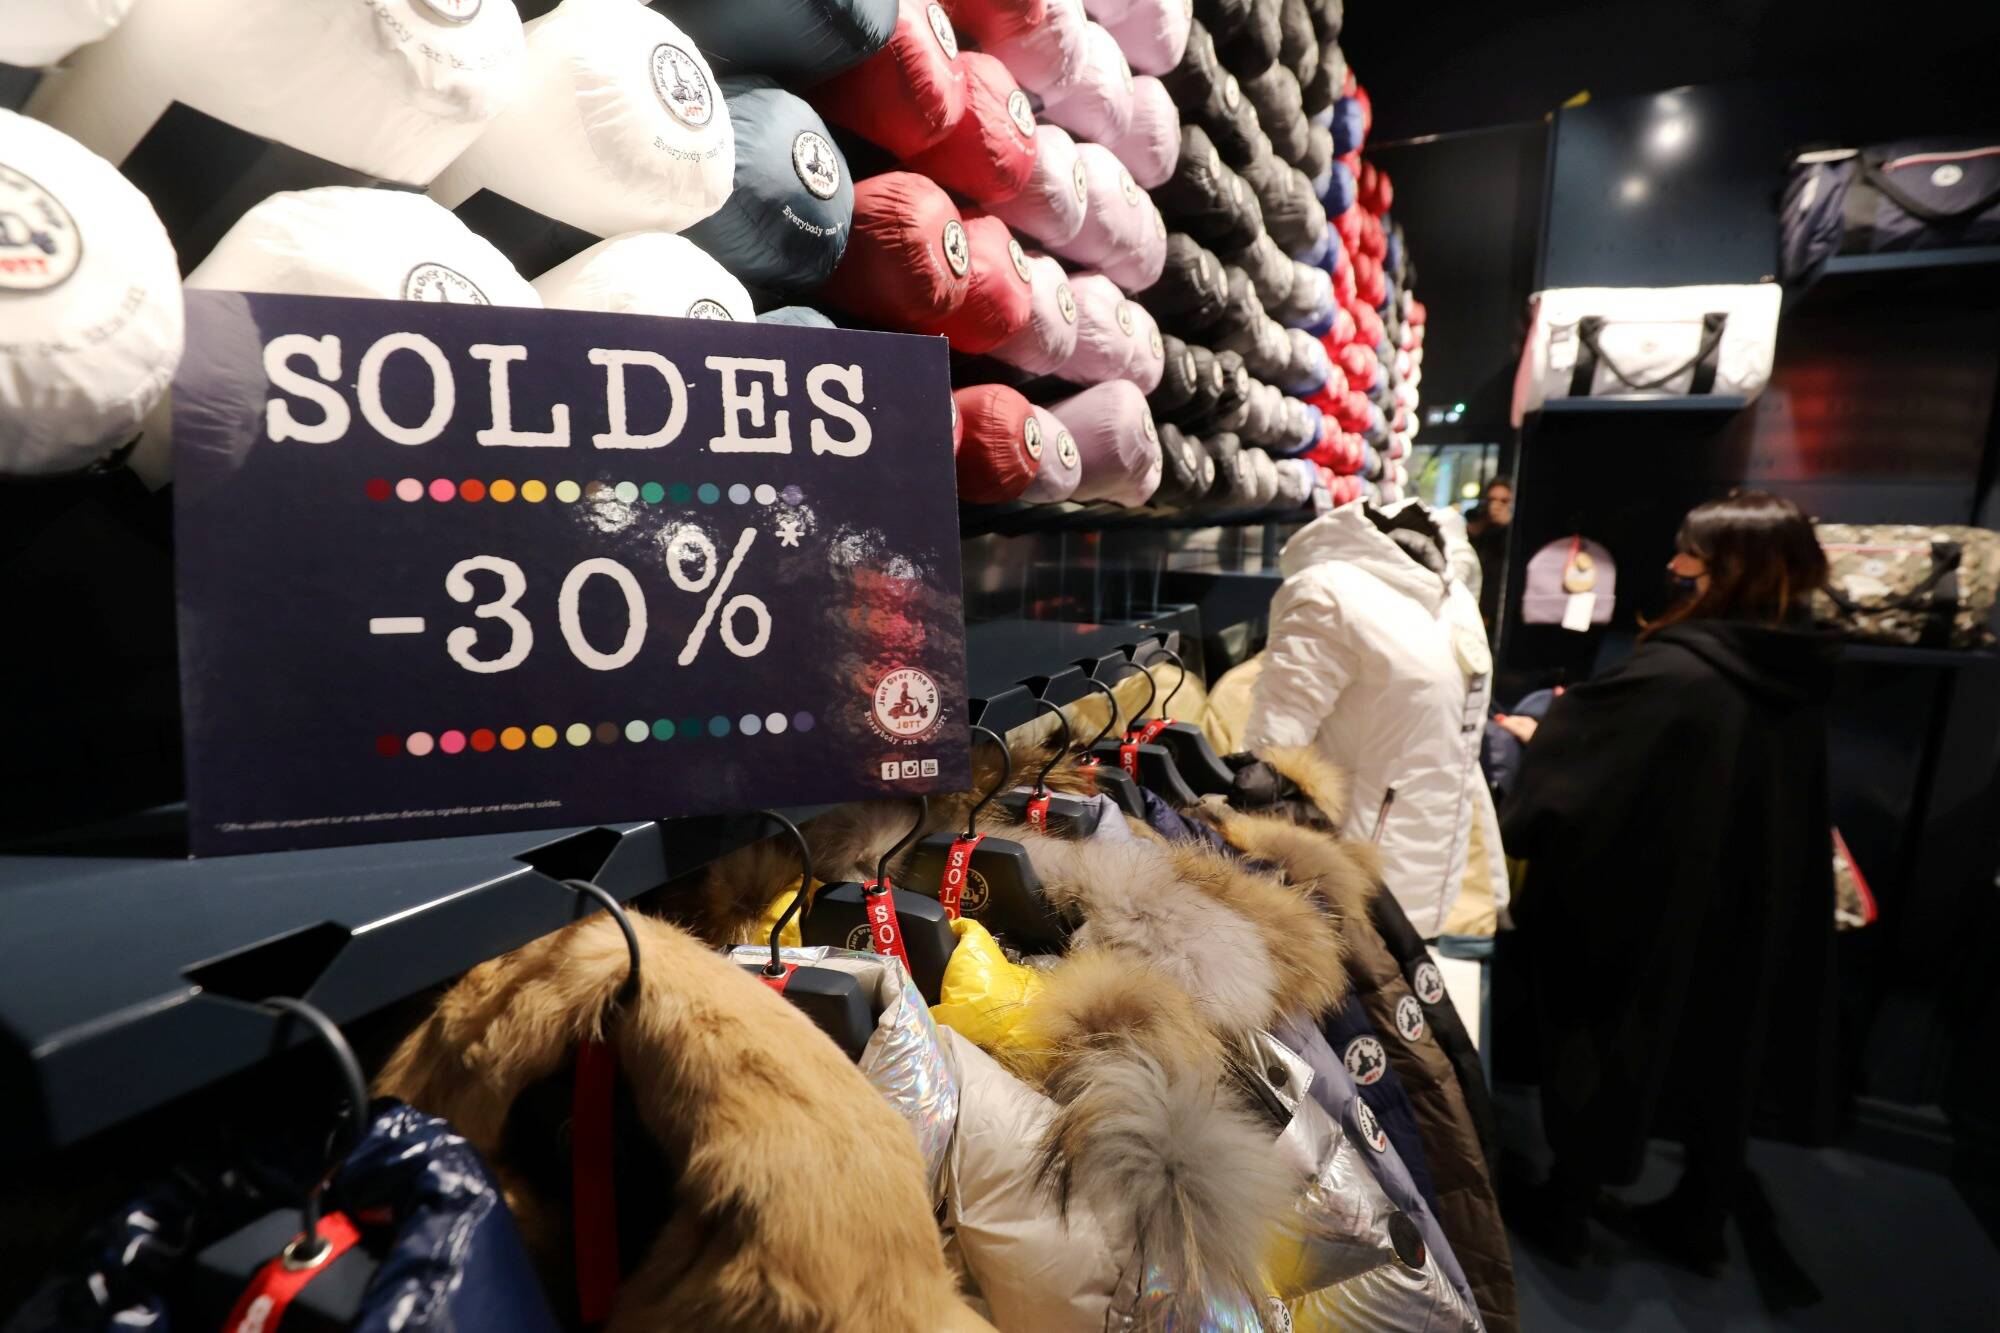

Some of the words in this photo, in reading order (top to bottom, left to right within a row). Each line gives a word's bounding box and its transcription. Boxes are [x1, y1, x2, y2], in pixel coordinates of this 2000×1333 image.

[782, 205, 824, 236] Everybody
[262, 331, 874, 459] SOLDES
[886, 672, 908, 686] Over
[912, 672, 928, 686] The
